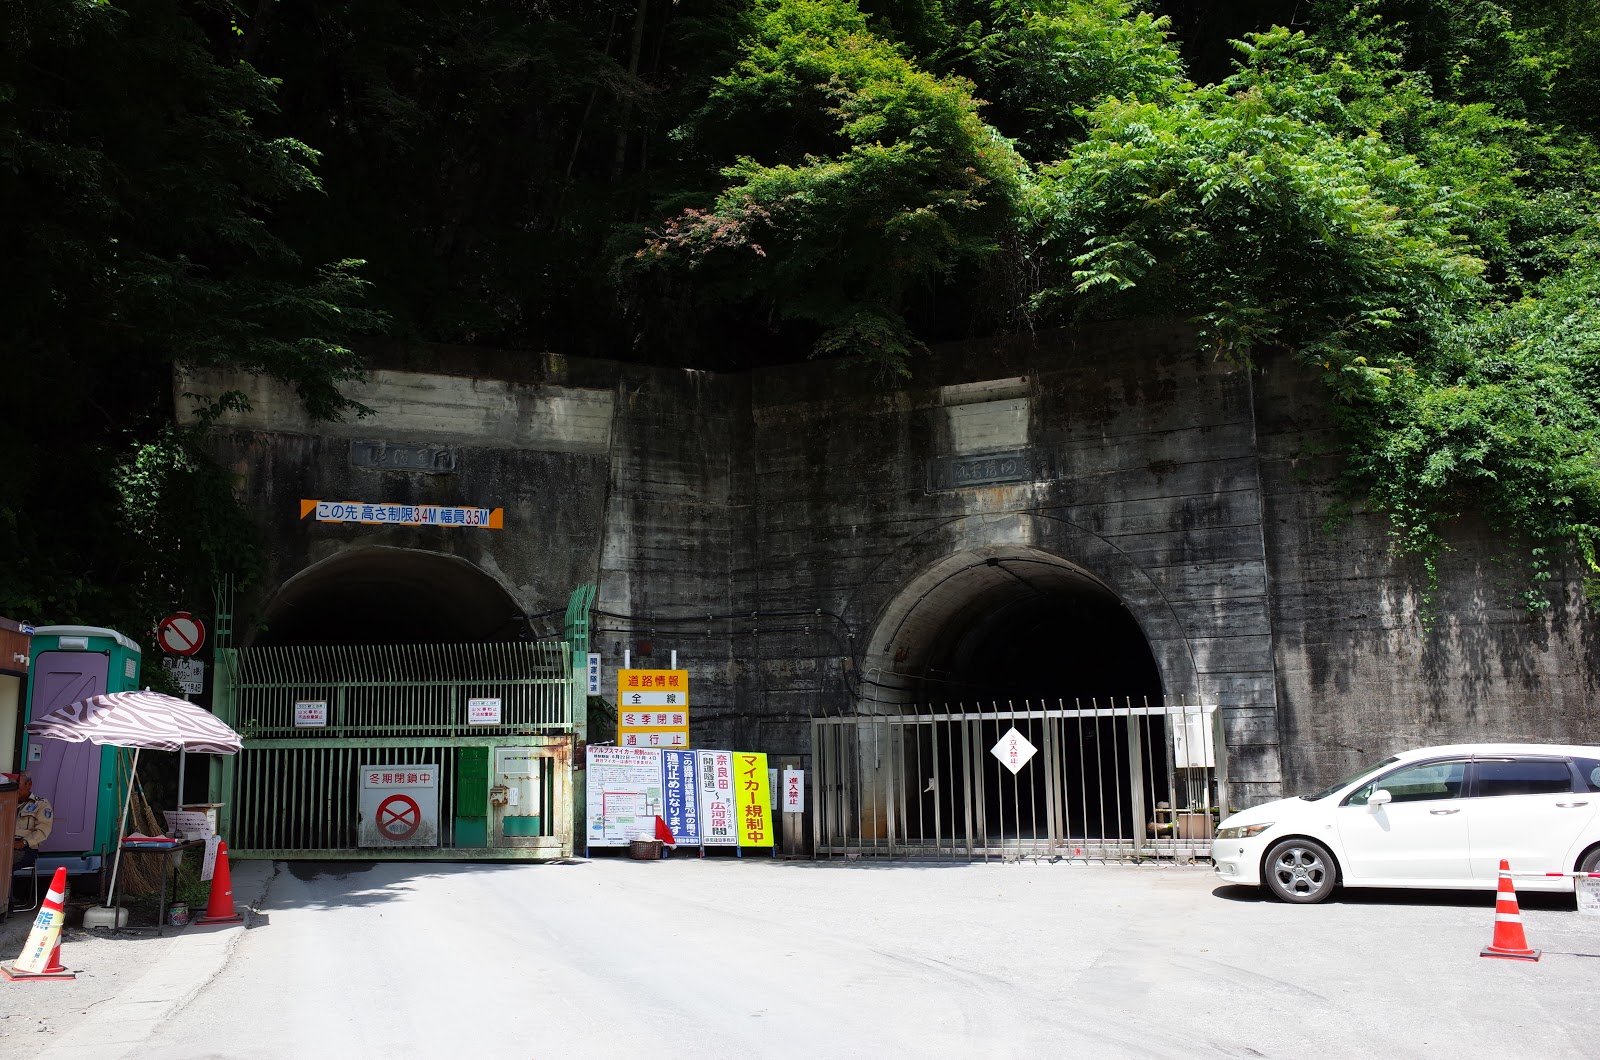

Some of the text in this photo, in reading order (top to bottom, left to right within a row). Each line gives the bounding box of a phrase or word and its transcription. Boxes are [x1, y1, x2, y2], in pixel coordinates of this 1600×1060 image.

[318, 504, 489, 526] この先 高さ制限3.4M 幅員3.5M
[628, 675, 680, 688] 道路情報
[625, 713, 683, 725] 冬季閉鎖
[626, 734, 682, 746] 通行止
[369, 772, 431, 785] 冬期閉鎖中
[716, 754, 729, 790] 奈良田
[666, 752, 681, 836] 通行止めになります
[741, 755, 764, 844] マイカー規制中
[788, 777, 799, 805] 進入禁止
